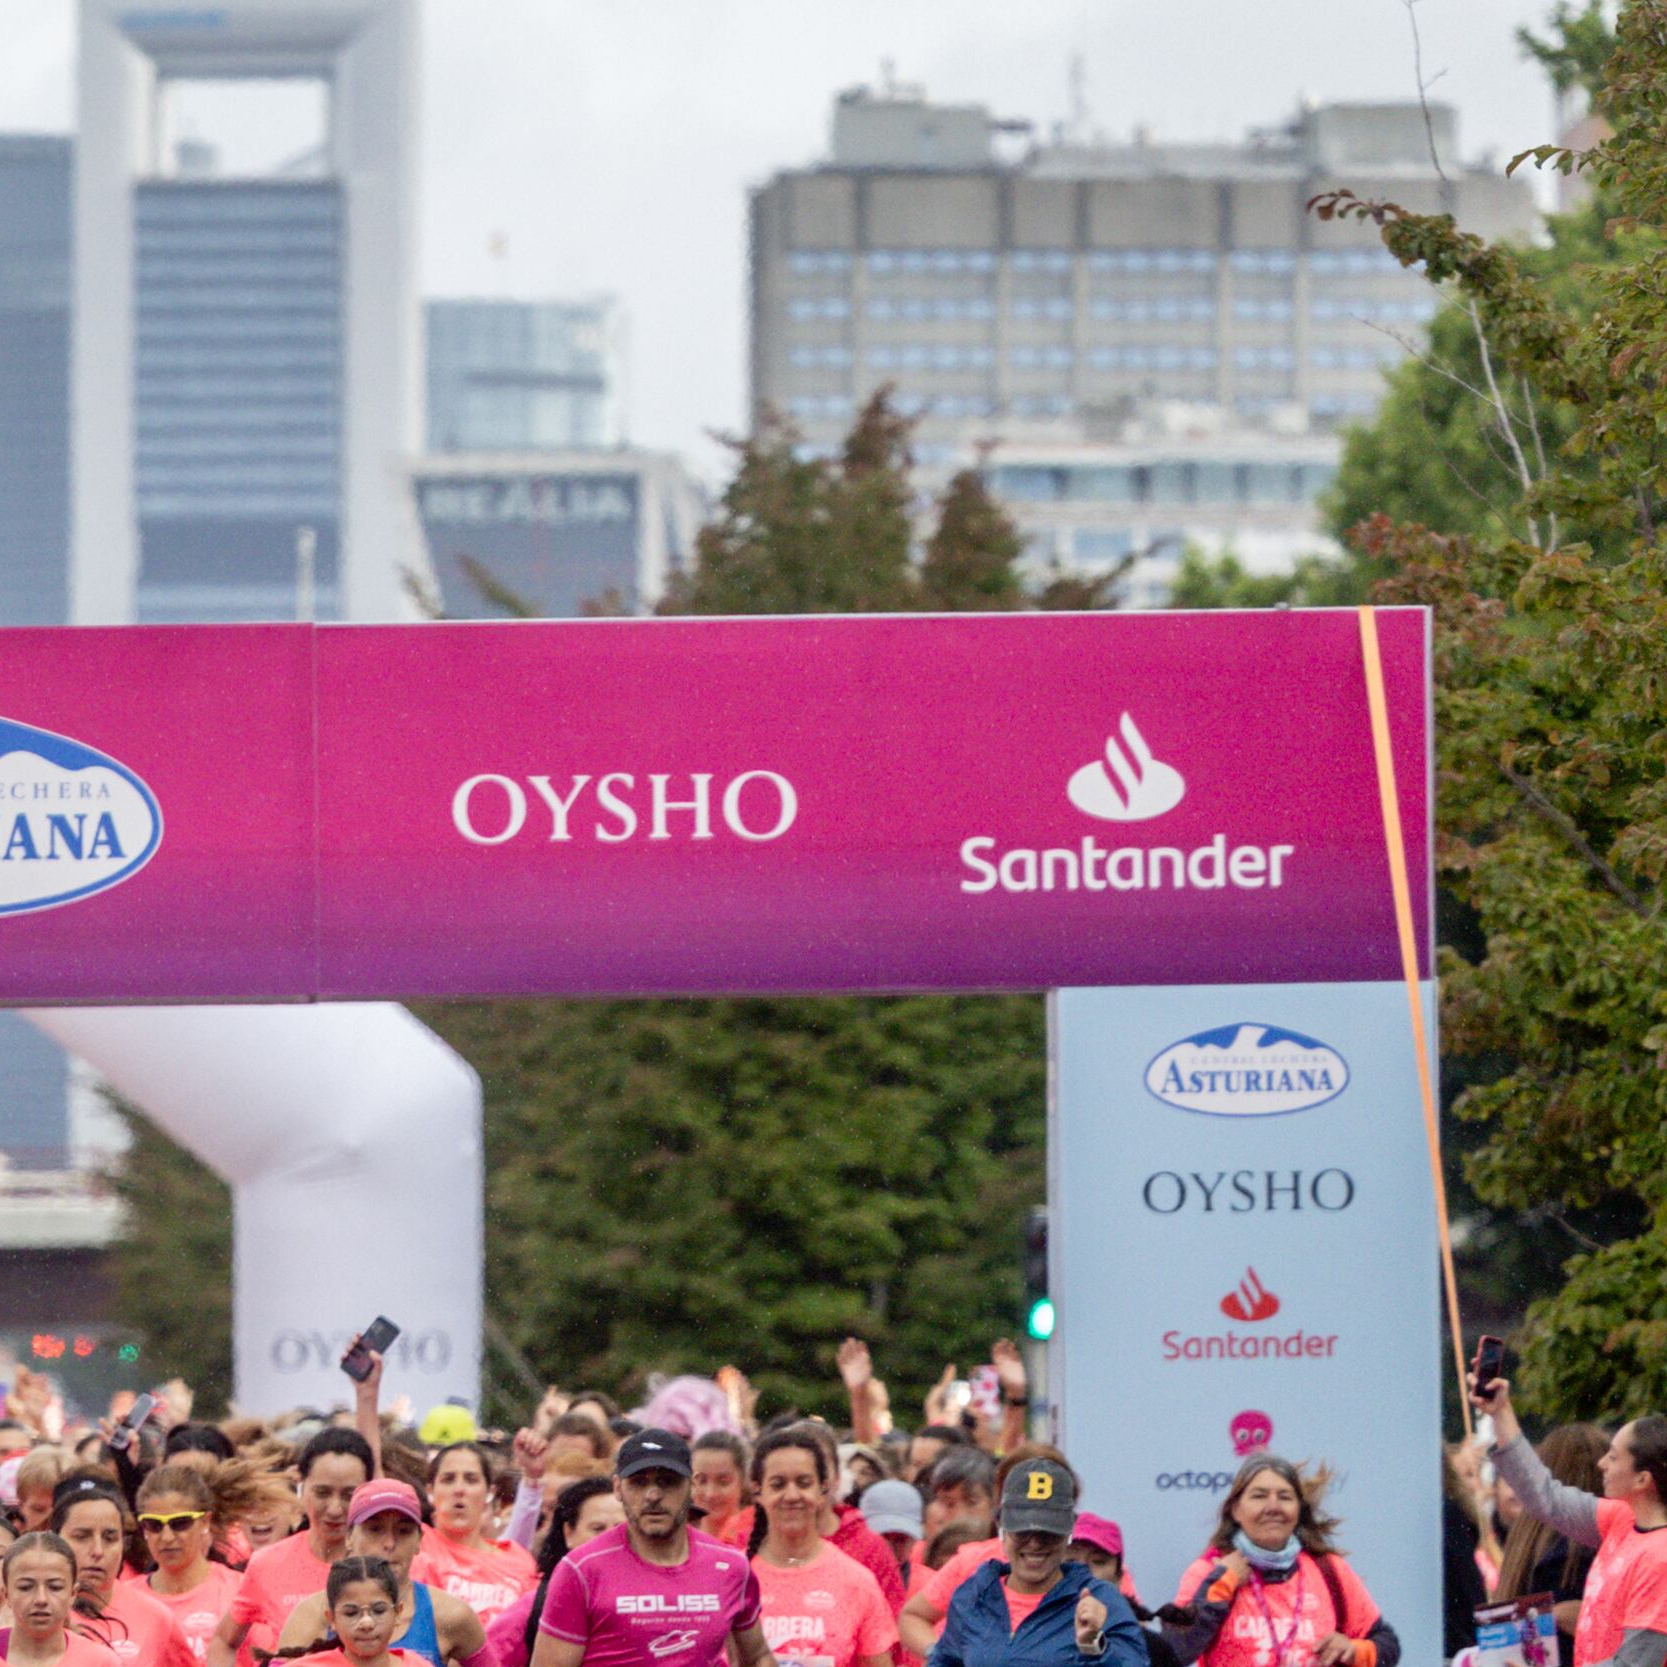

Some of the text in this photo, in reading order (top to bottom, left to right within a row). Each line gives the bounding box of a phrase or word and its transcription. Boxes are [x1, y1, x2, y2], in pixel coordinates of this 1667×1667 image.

[450, 769, 798, 844] OYSHO
[959, 833, 1294, 894] Santander
[1160, 1058, 1334, 1094] ASTURIANA
[1142, 1168, 1355, 1214] OYSHO
[1162, 1331, 1339, 1360] Santander
[1027, 1472, 1054, 1500] B
[616, 1593, 721, 1614] SOLISS
